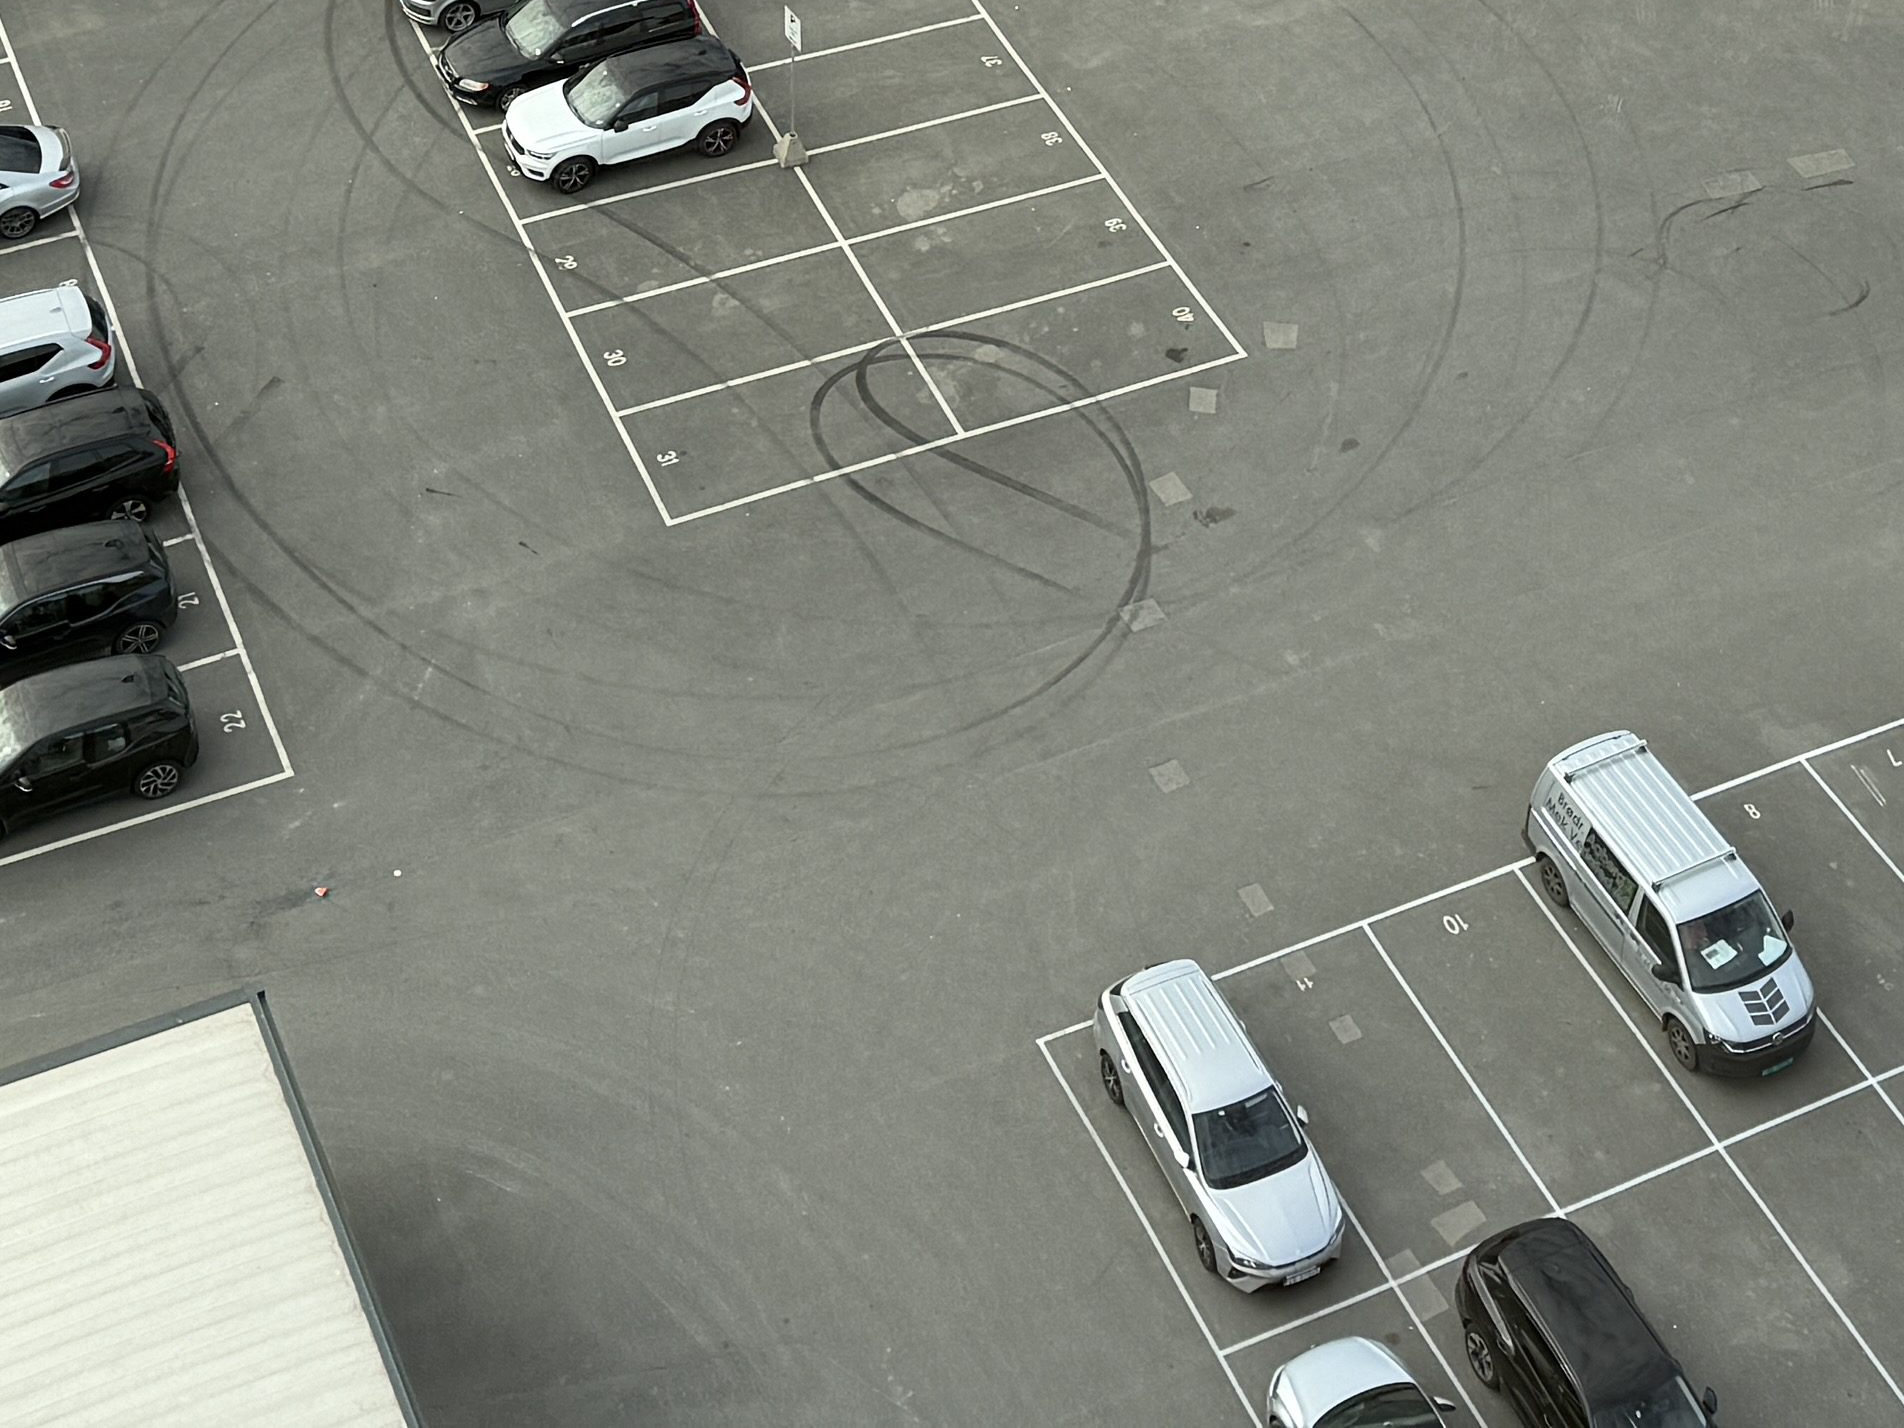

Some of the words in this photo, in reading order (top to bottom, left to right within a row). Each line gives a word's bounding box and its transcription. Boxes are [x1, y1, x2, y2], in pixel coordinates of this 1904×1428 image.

[1041, 131, 1063, 146] 38
[1105, 218, 1127, 233] 39
[603, 349, 627, 366] 30
[656, 450, 680, 467] 31
[220, 710, 246, 733] 22
[1744, 803, 1761, 819] 8
[1442, 913, 1469, 935] 10
